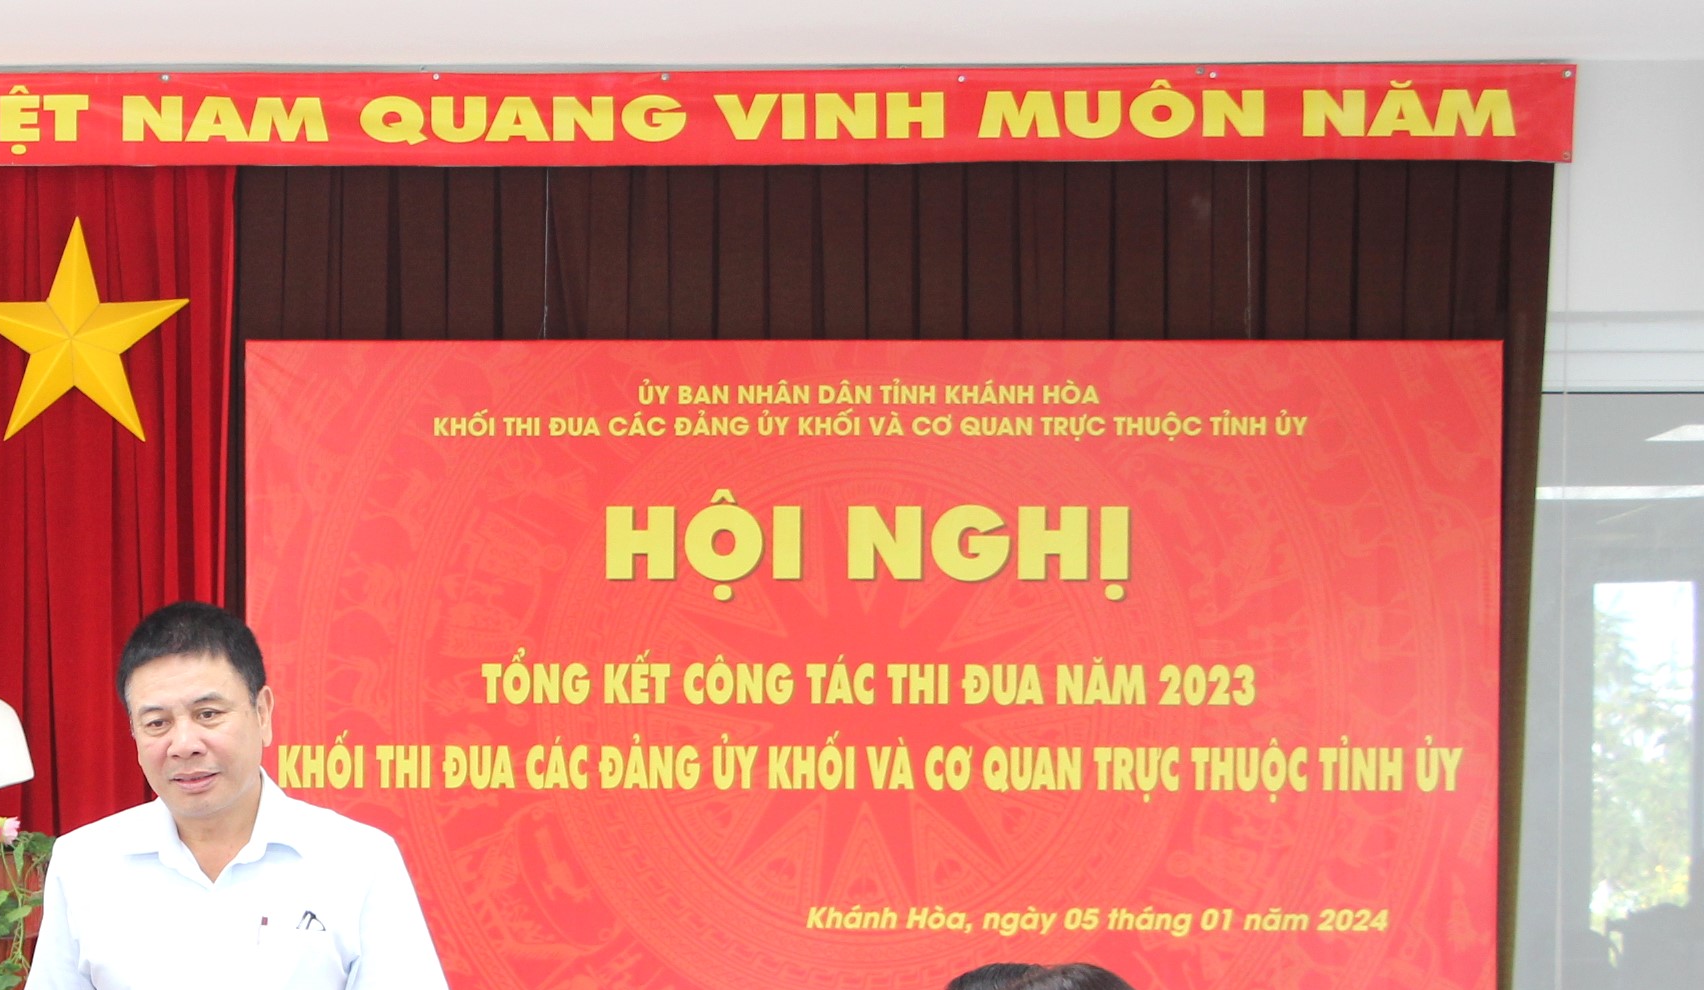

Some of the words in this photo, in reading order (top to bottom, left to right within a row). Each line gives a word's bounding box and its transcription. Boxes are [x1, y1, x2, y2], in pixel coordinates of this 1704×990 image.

[121, 95, 330, 143] NAM
[359, 94, 688, 146] QUANG
[713, 91, 945, 141] VINH
[977, 79, 1266, 139] MUÔN
[1302, 79, 1517, 137] NĂM
[638, 378, 671, 406] ỦY
[677, 384, 730, 405] BAN
[737, 379, 811, 405] NHÂN
[817, 378, 873, 405] DÂN
[879, 377, 938, 405] TỈNH
[944, 379, 1036, 405] KHÁNH
[1042, 378, 1101, 405] HÒA
[433, 408, 497, 437] KHỐI
[502, 416, 542, 437] THI
[547, 416, 602, 437] ĐUA
[607, 410, 667, 437] CÁC
[673, 409, 752, 437] ĐẢNG
[757, 408, 791, 437] ỦY
[797, 407, 862, 437] KHỐI
[868, 410, 905, 437] VÀ
[911, 413, 954, 437] CƠ
[959, 415, 1035, 437] QUAN
[1040, 413, 1107, 442] TRỰC
[1113, 410, 1203, 442] THUỘC
[1209, 408, 1268, 437] TỈNH
[1274, 409, 1308, 437] ỦY
[605, 488, 802, 601] HỘI
[847, 503, 1131, 601] NGHỊ
[480, 646, 593, 706] TỔNG
[603, 648, 673, 705] KẾT
[682, 653, 796, 706] CÔNG
[805, 654, 877, 706] TÁC
[886, 663, 951, 705] THI
[960, 662, 1046, 707] ĐUA
[1055, 655, 1148, 707] NĂM
[1158, 663, 1258, 708] 2023
[277, 729, 367, 790] KHỐI
[375, 744, 434, 790] THI
[441, 744, 518, 791] ĐUA
[525, 735, 591, 791] CÁC
[597, 732, 704, 792] ĐẢNG
[711, 731, 760, 792] ỦY
[767, 730, 858, 791] KHỐI
[865, 736, 916, 791] VÀ
[924, 744, 974, 793] CƠ
[982, 744, 1085, 794] QUAN
[1092, 744, 1183, 804] TRỰC
[1189, 737, 1310, 805] THUỘC
[1317, 735, 1406, 793] TỈNH
[1415, 734, 1465, 794] ỦY
[805, 903, 901, 931] Khánh
[905, 904, 975, 935] Hòa,
[981, 905, 1059, 938] ngày
[1063, 906, 1103, 933] 05
[1106, 905, 1195, 939] tháng
[1199, 907, 1235, 933] 01
[1242, 906, 1311, 933] năm
[1316, 907, 1390, 933] 2024
